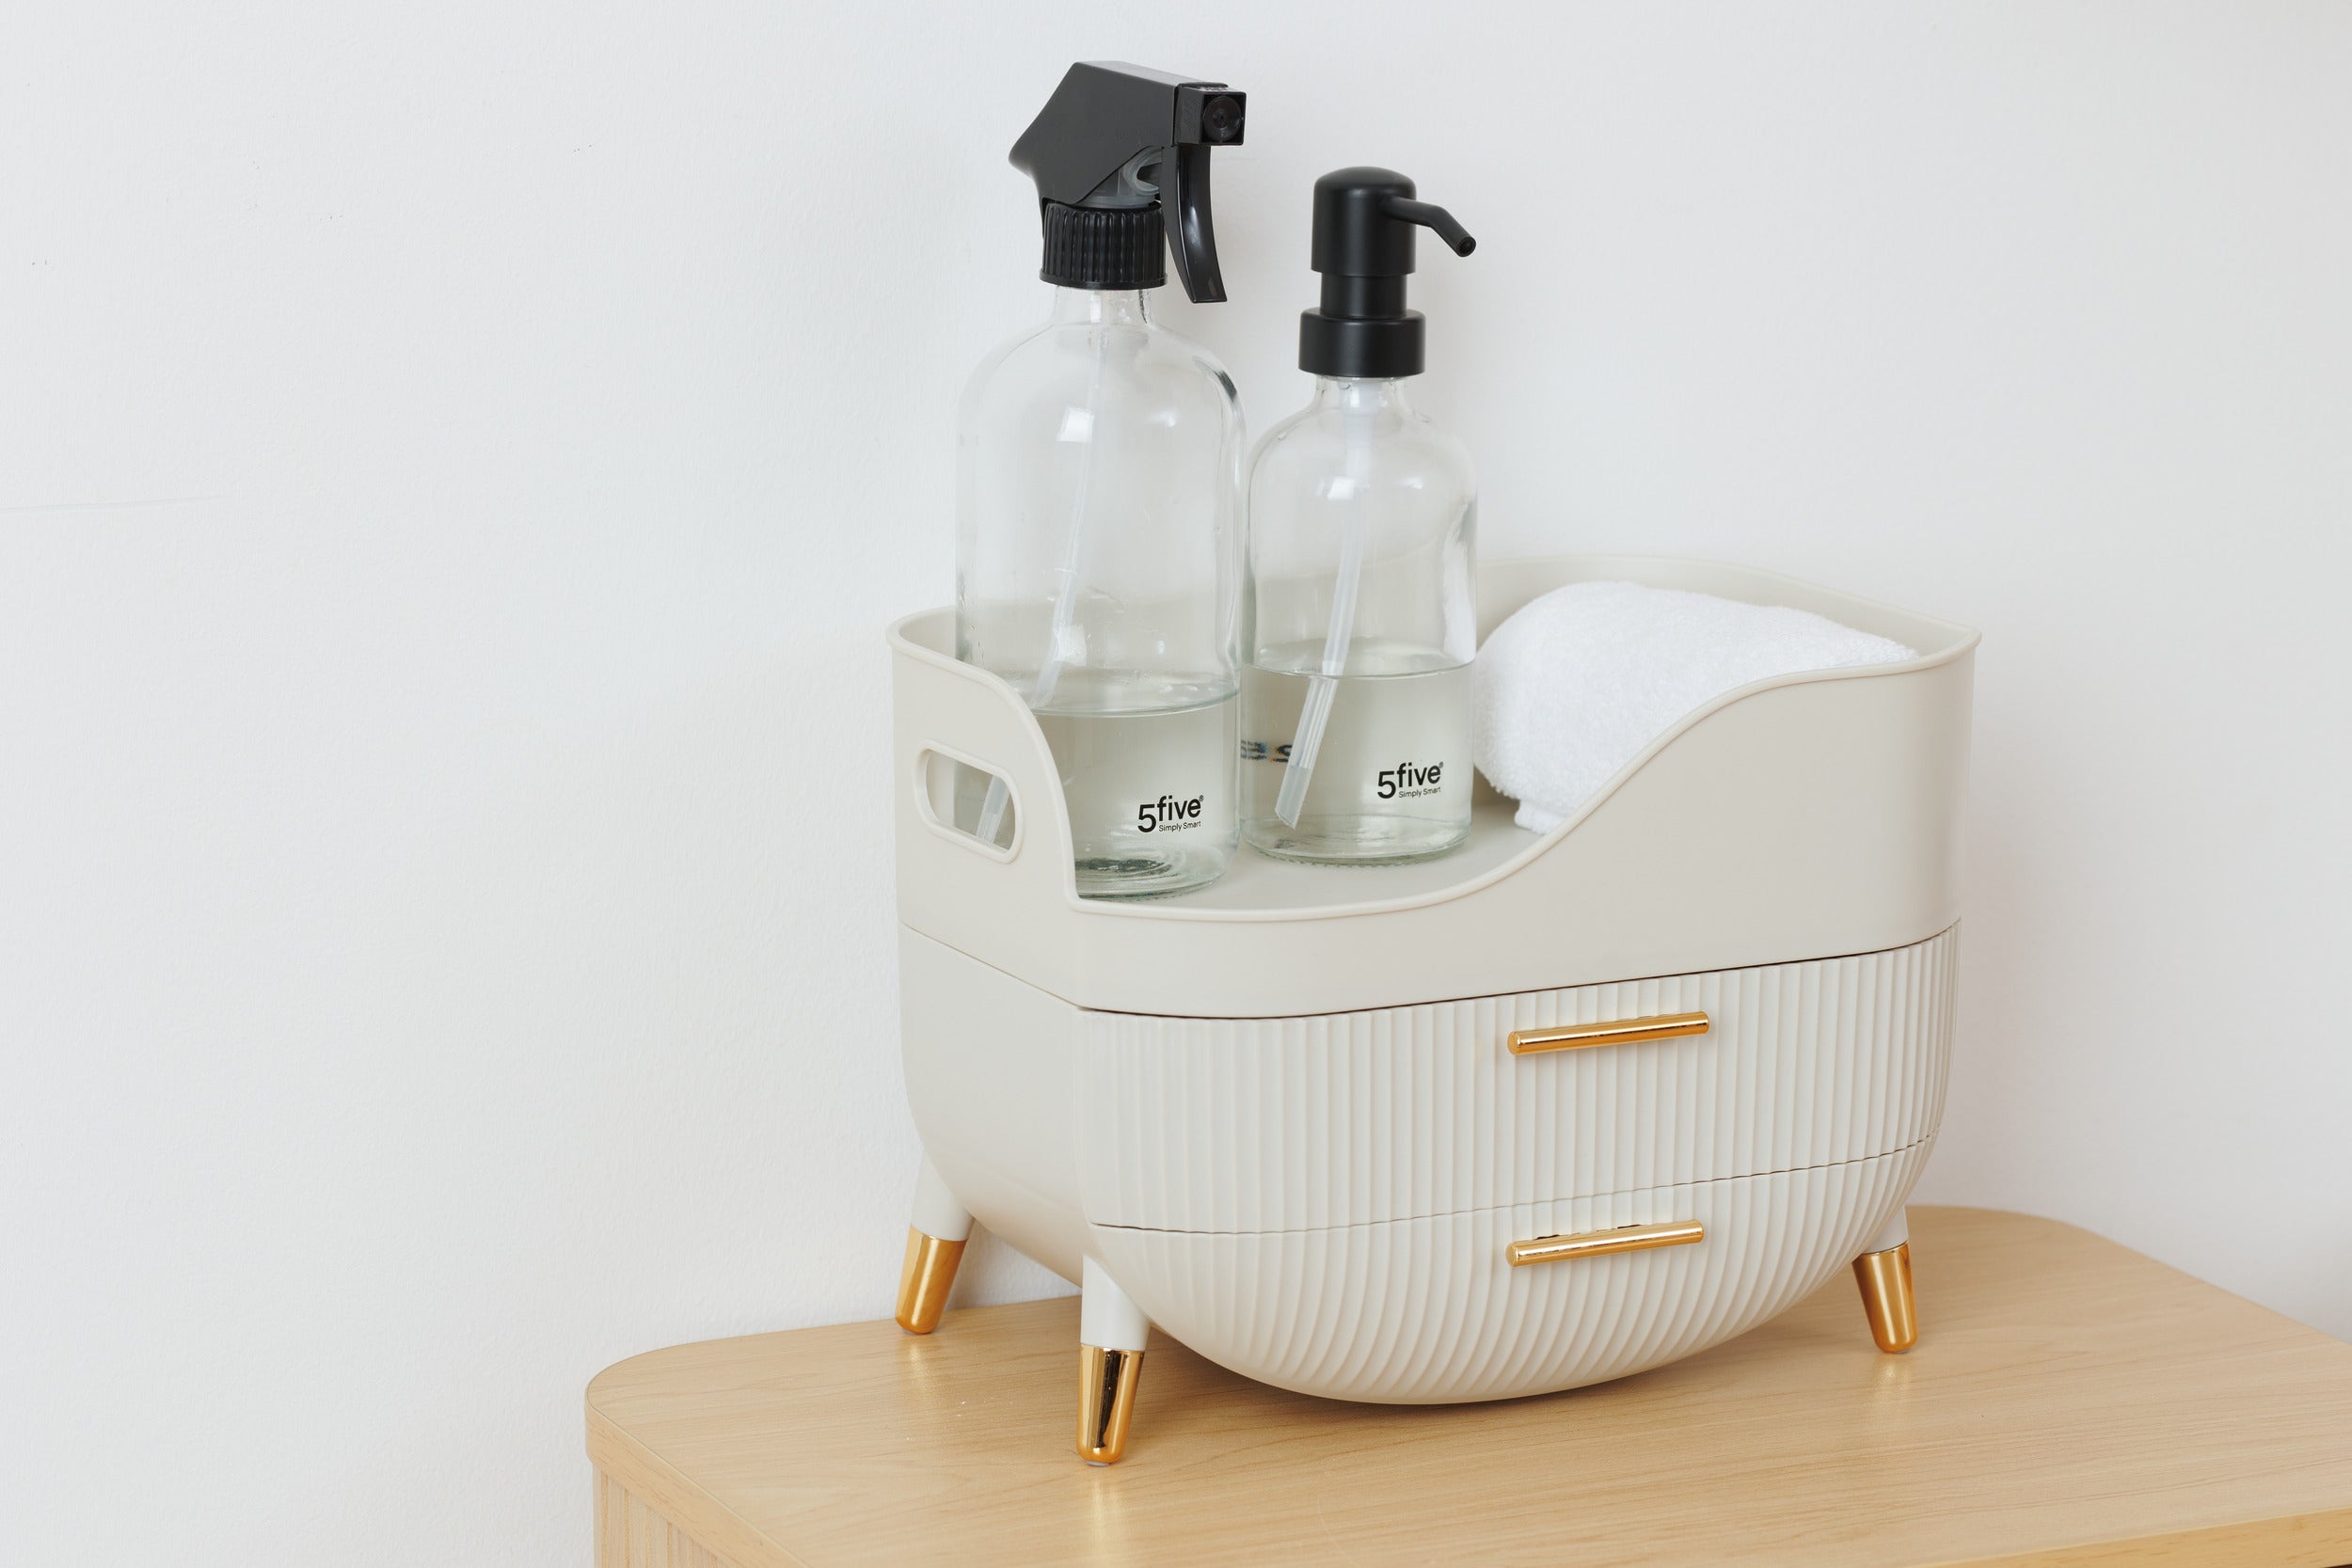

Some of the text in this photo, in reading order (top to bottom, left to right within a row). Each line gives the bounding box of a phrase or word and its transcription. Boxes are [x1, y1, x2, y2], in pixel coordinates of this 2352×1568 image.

[1398, 786, 1441, 799] Simply Smart
[1158, 820, 1201, 832] Simply Smart
